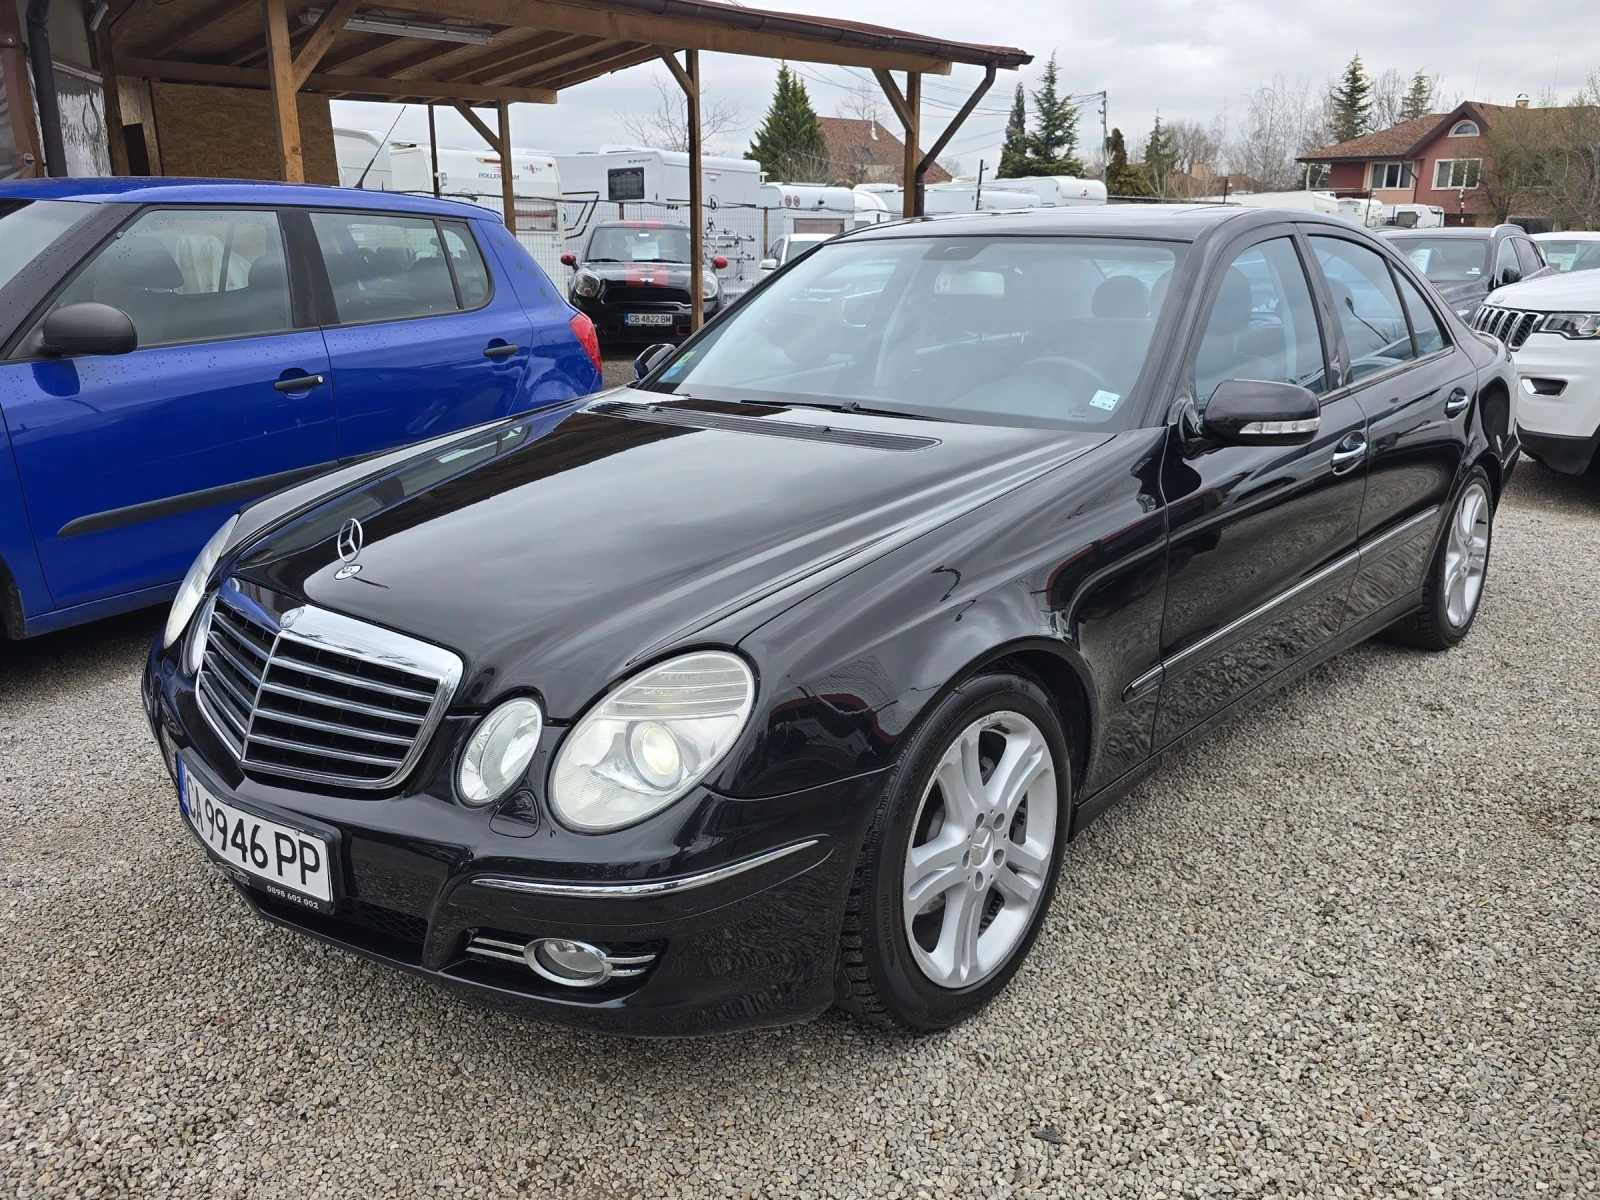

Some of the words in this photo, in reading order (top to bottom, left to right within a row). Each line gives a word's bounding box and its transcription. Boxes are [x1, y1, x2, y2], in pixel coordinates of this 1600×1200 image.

[478, 172, 520, 181] ROLLERM
[630, 315, 640, 323] CB
[641, 315, 660, 323] 4822
[661, 315, 671, 323] BM
[187, 774, 205, 833] CA
[205, 798, 268, 869] 9946
[274, 831, 320, 886] PP
[266, 885, 286, 898] 0898
[287, 892, 302, 904] 602
[303, 898, 319, 909] 002
